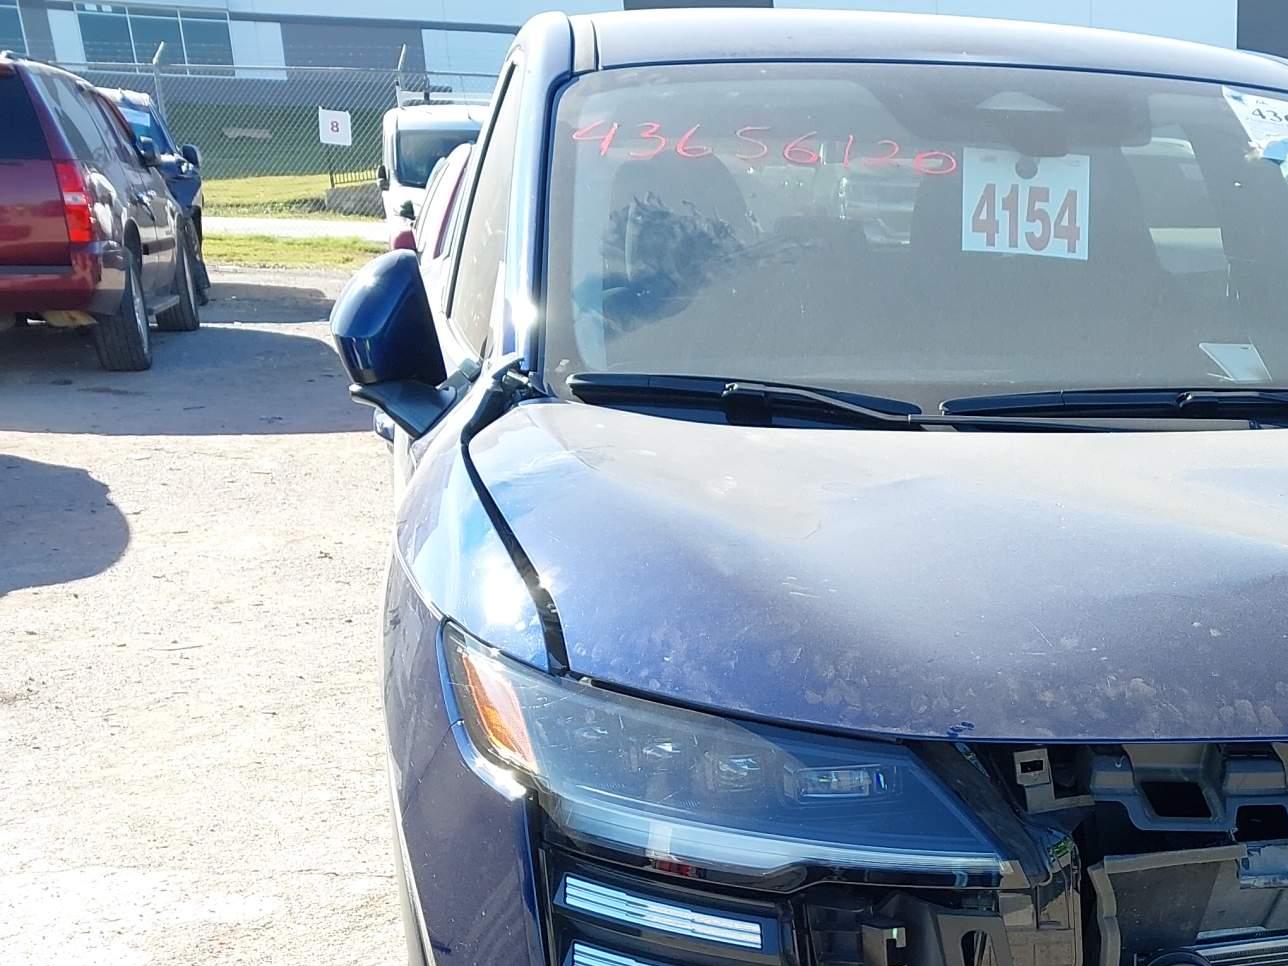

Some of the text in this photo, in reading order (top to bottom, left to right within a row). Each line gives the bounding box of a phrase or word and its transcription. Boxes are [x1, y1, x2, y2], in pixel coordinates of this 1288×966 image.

[330, 120, 340, 133] 8
[572, 121, 957, 176] 43656120
[971, 183, 1081, 254] 4154
